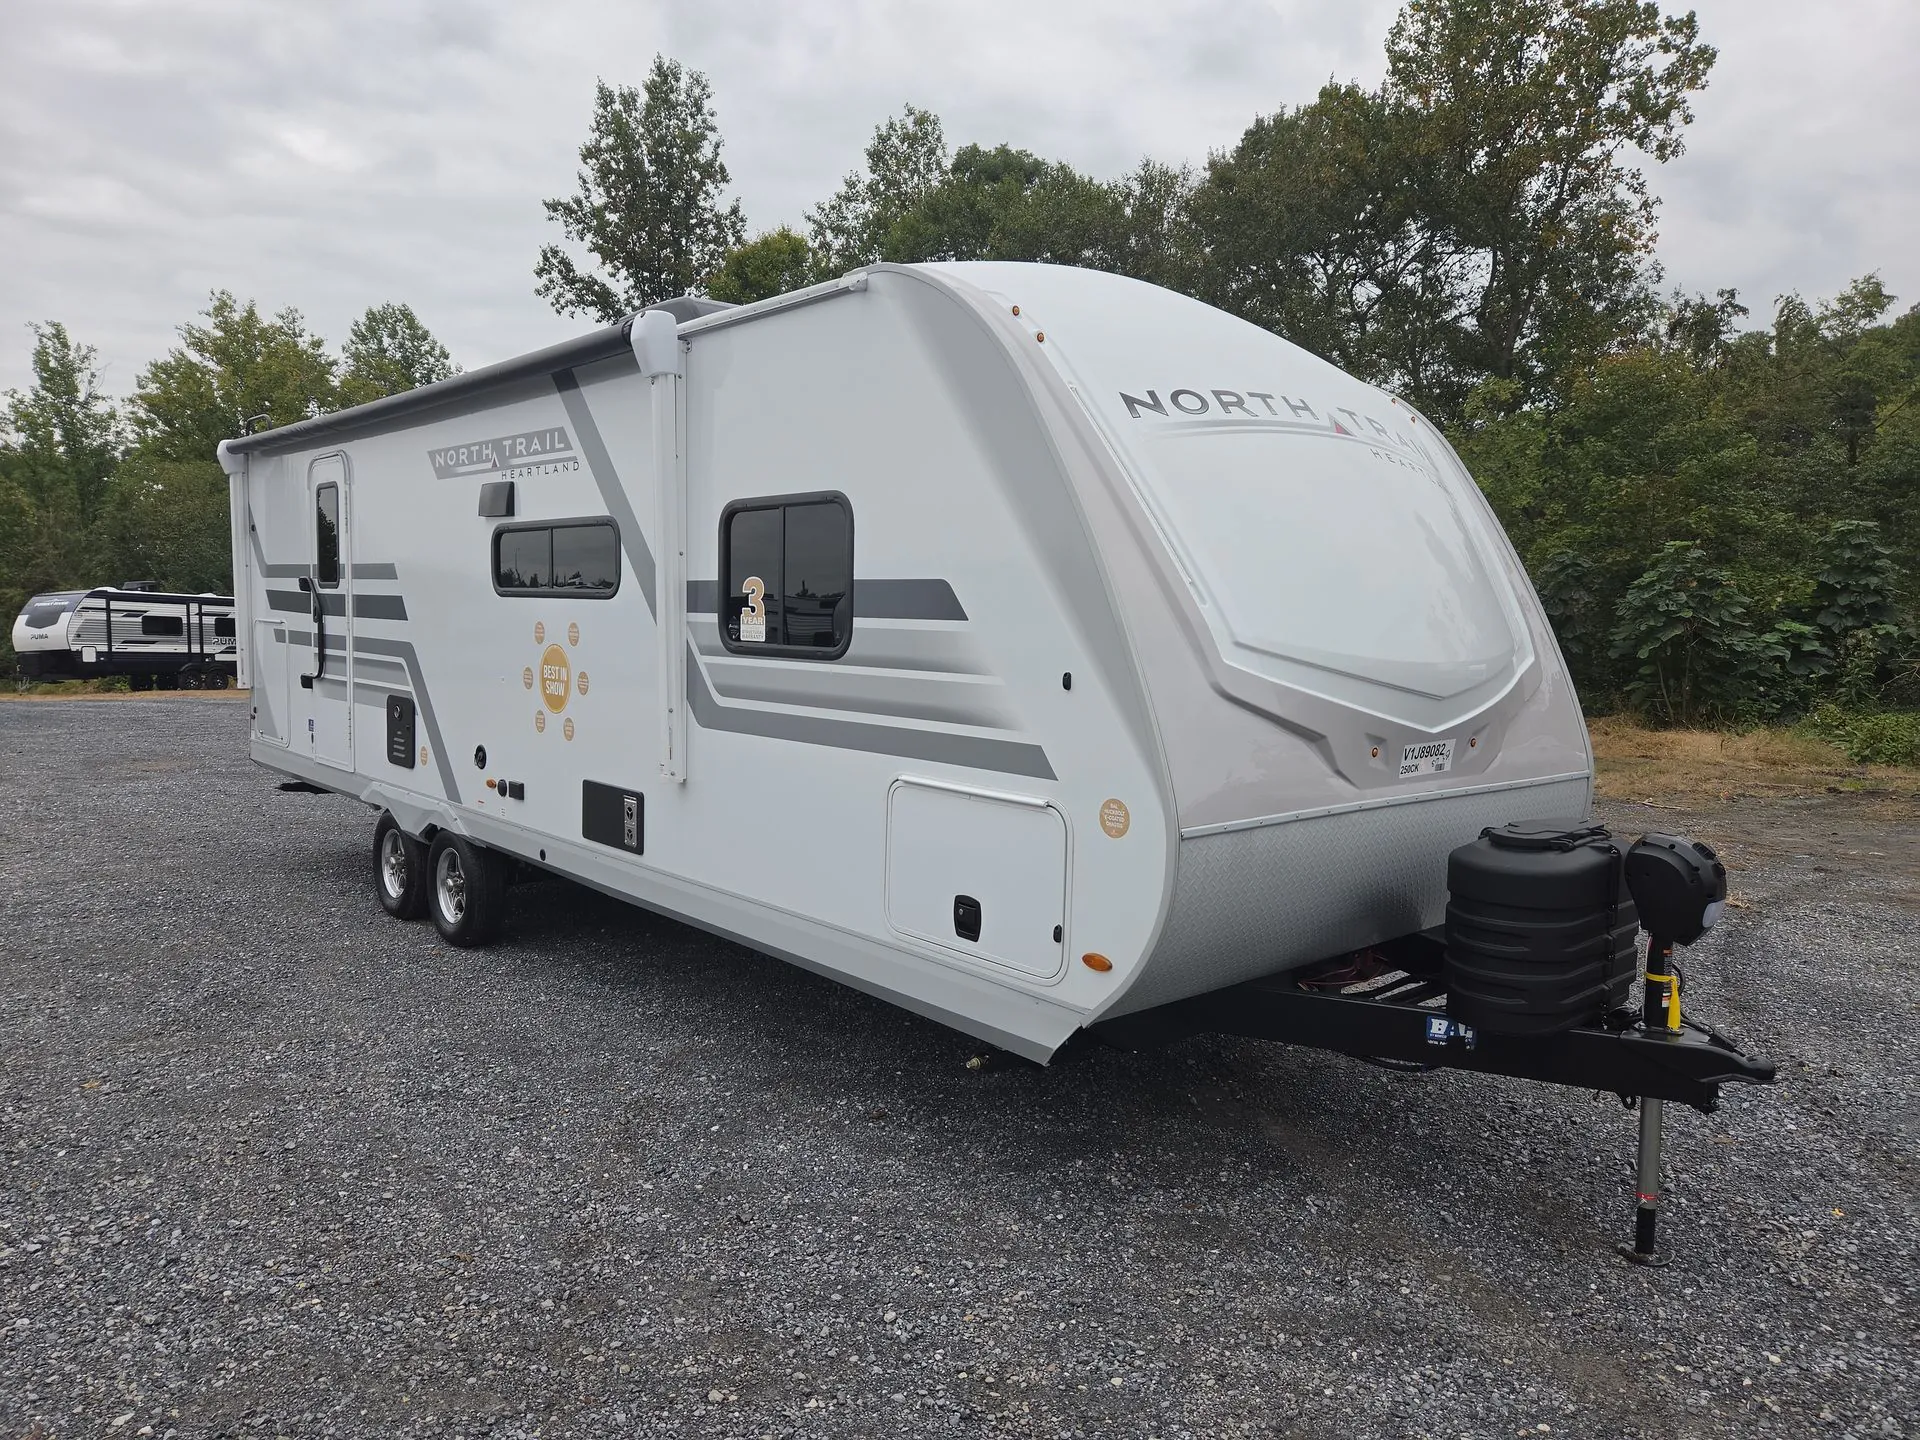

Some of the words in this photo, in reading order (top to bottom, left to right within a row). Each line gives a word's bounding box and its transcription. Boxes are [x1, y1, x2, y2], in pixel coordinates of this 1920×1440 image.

[1118, 389, 1320, 420] NORTH
[435, 444, 493, 468] NORTH
[502, 431, 565, 457] TRAIL
[501, 461, 580, 480] HEARTLAND
[742, 576, 765, 617] 3
[742, 617, 764, 625] YEAR
[211, 637, 236, 646] PUM
[543, 664, 559, 680] BEST
[560, 666, 567, 681] IN
[546, 680, 565, 697] SHOW
[1404, 743, 1446, 761] V1J89082
